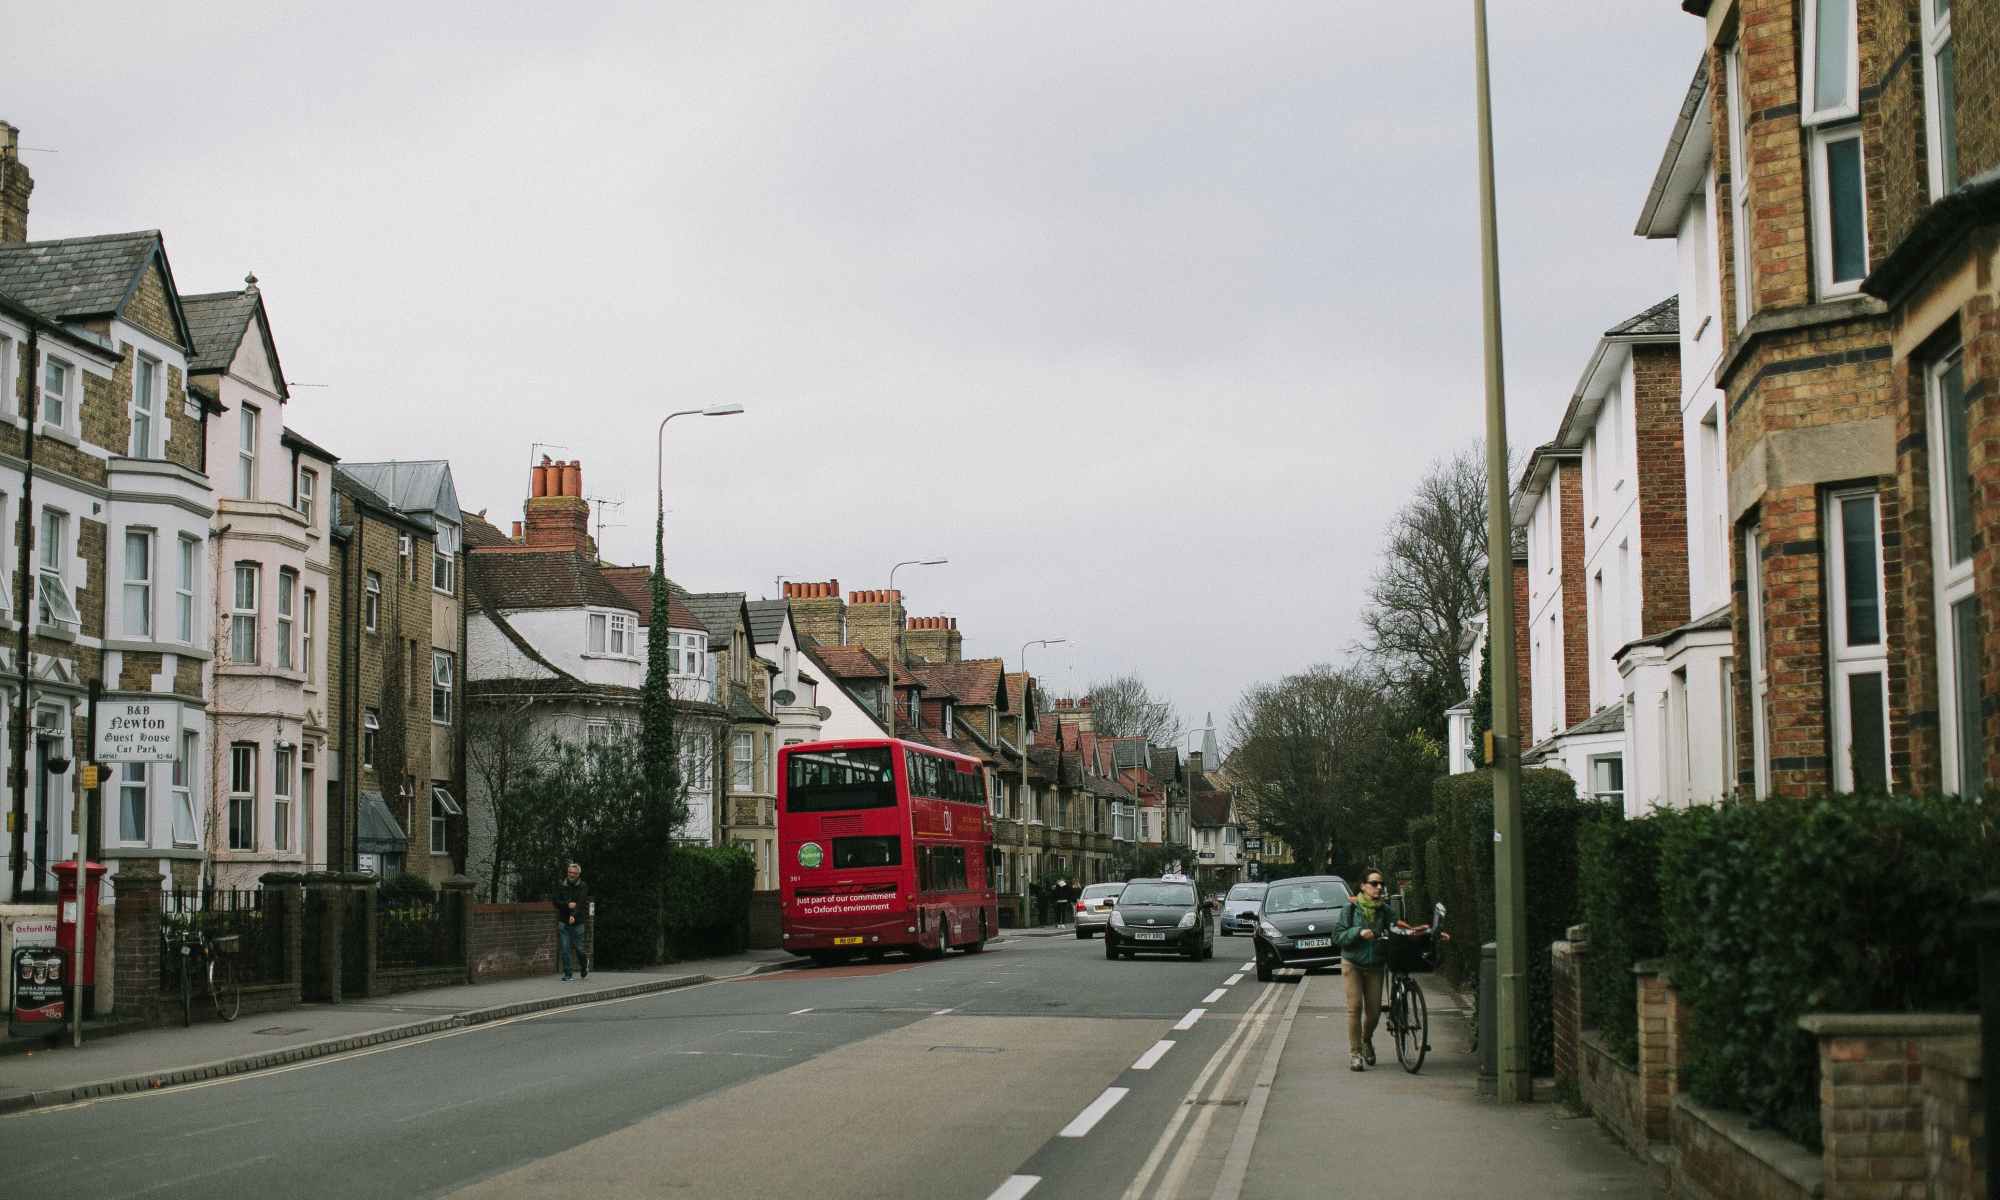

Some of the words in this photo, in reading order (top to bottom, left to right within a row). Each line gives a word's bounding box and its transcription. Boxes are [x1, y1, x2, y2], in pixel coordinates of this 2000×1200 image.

[127, 705, 150, 715] B&B
[108, 716, 165, 729] Newton
[104, 733, 133, 742] Guest
[140, 732, 170, 742] House
[116, 745, 131, 753] Car
[137, 745, 157, 753] Park
[811, 896, 827, 905] part
[849, 892, 896, 901] commitment
[813, 905, 842, 914] Oxford's
[843, 903, 890, 912] environment
[16, 926, 43, 934] Oxford
